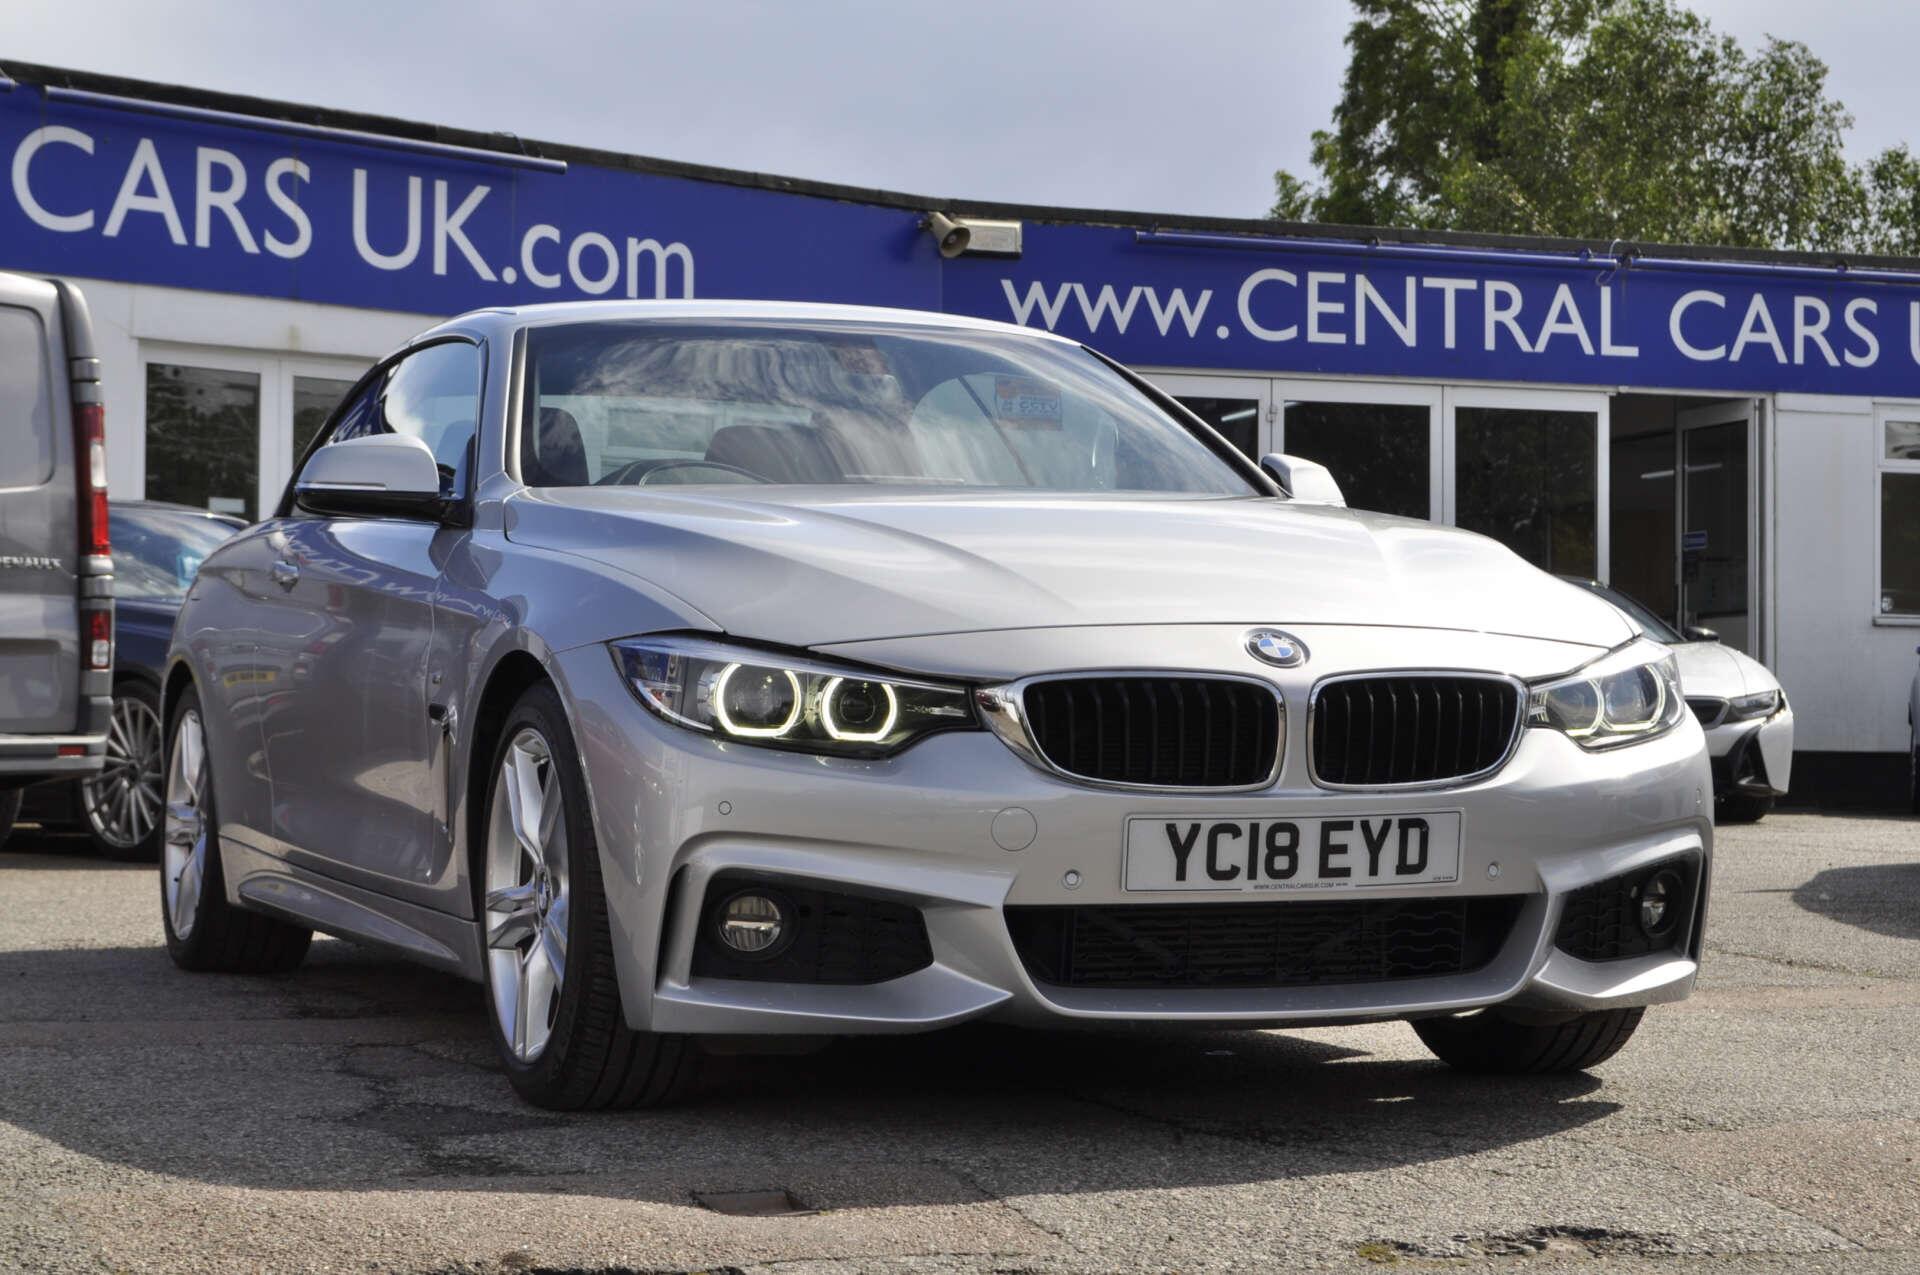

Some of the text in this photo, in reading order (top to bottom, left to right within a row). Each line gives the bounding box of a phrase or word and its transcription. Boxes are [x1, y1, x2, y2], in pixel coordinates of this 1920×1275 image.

[12, 126, 313, 259] CARS
[1669, 290, 1880, 368] CARS
[0, 556, 62, 570] ENAULT
[1165, 818, 1430, 881] YC18 EYD
